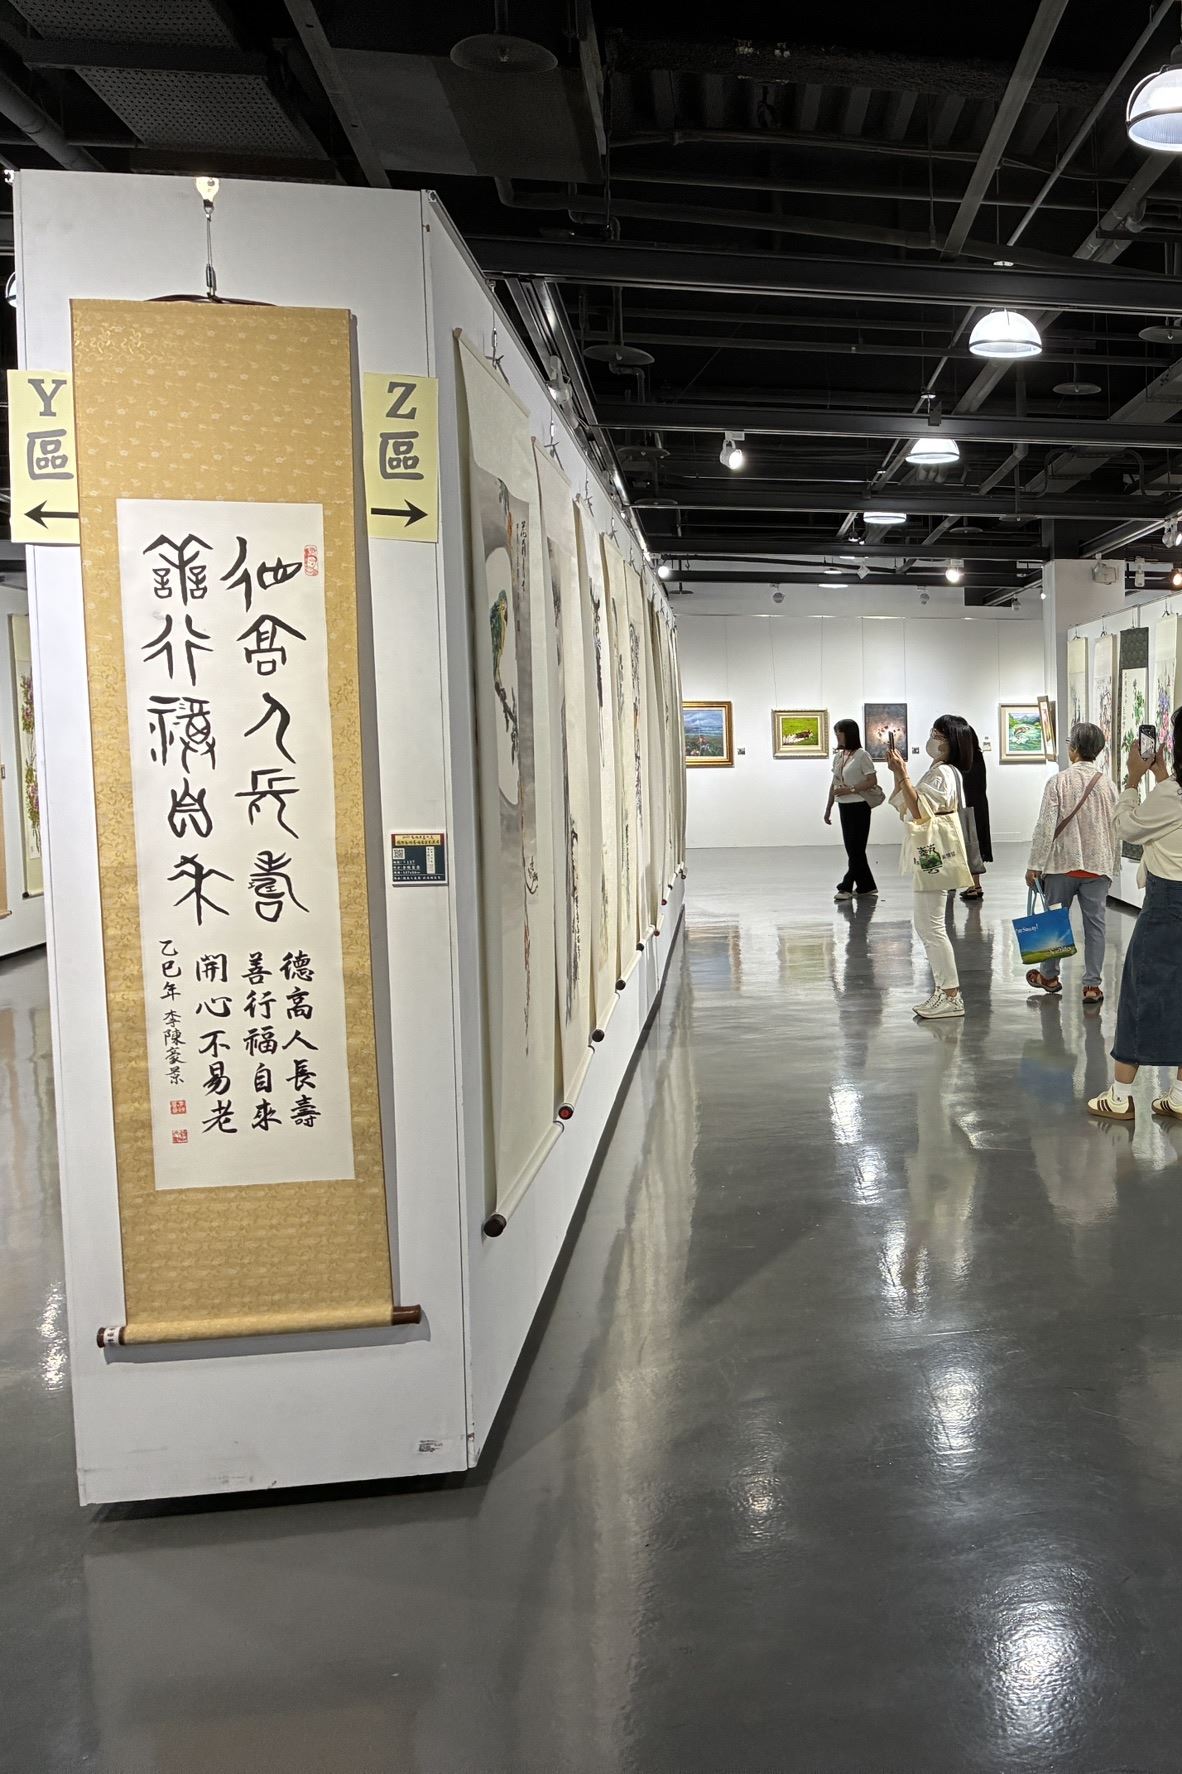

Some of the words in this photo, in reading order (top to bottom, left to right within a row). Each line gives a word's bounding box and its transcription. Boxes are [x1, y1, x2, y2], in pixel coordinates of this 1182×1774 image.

[159, 939, 182, 1001] 乙巳年
[195, 953, 237, 1134] 開心不易老
[242, 951, 284, 1131] 善行福自來
[279, 950, 320, 1128] 德高人長壽
